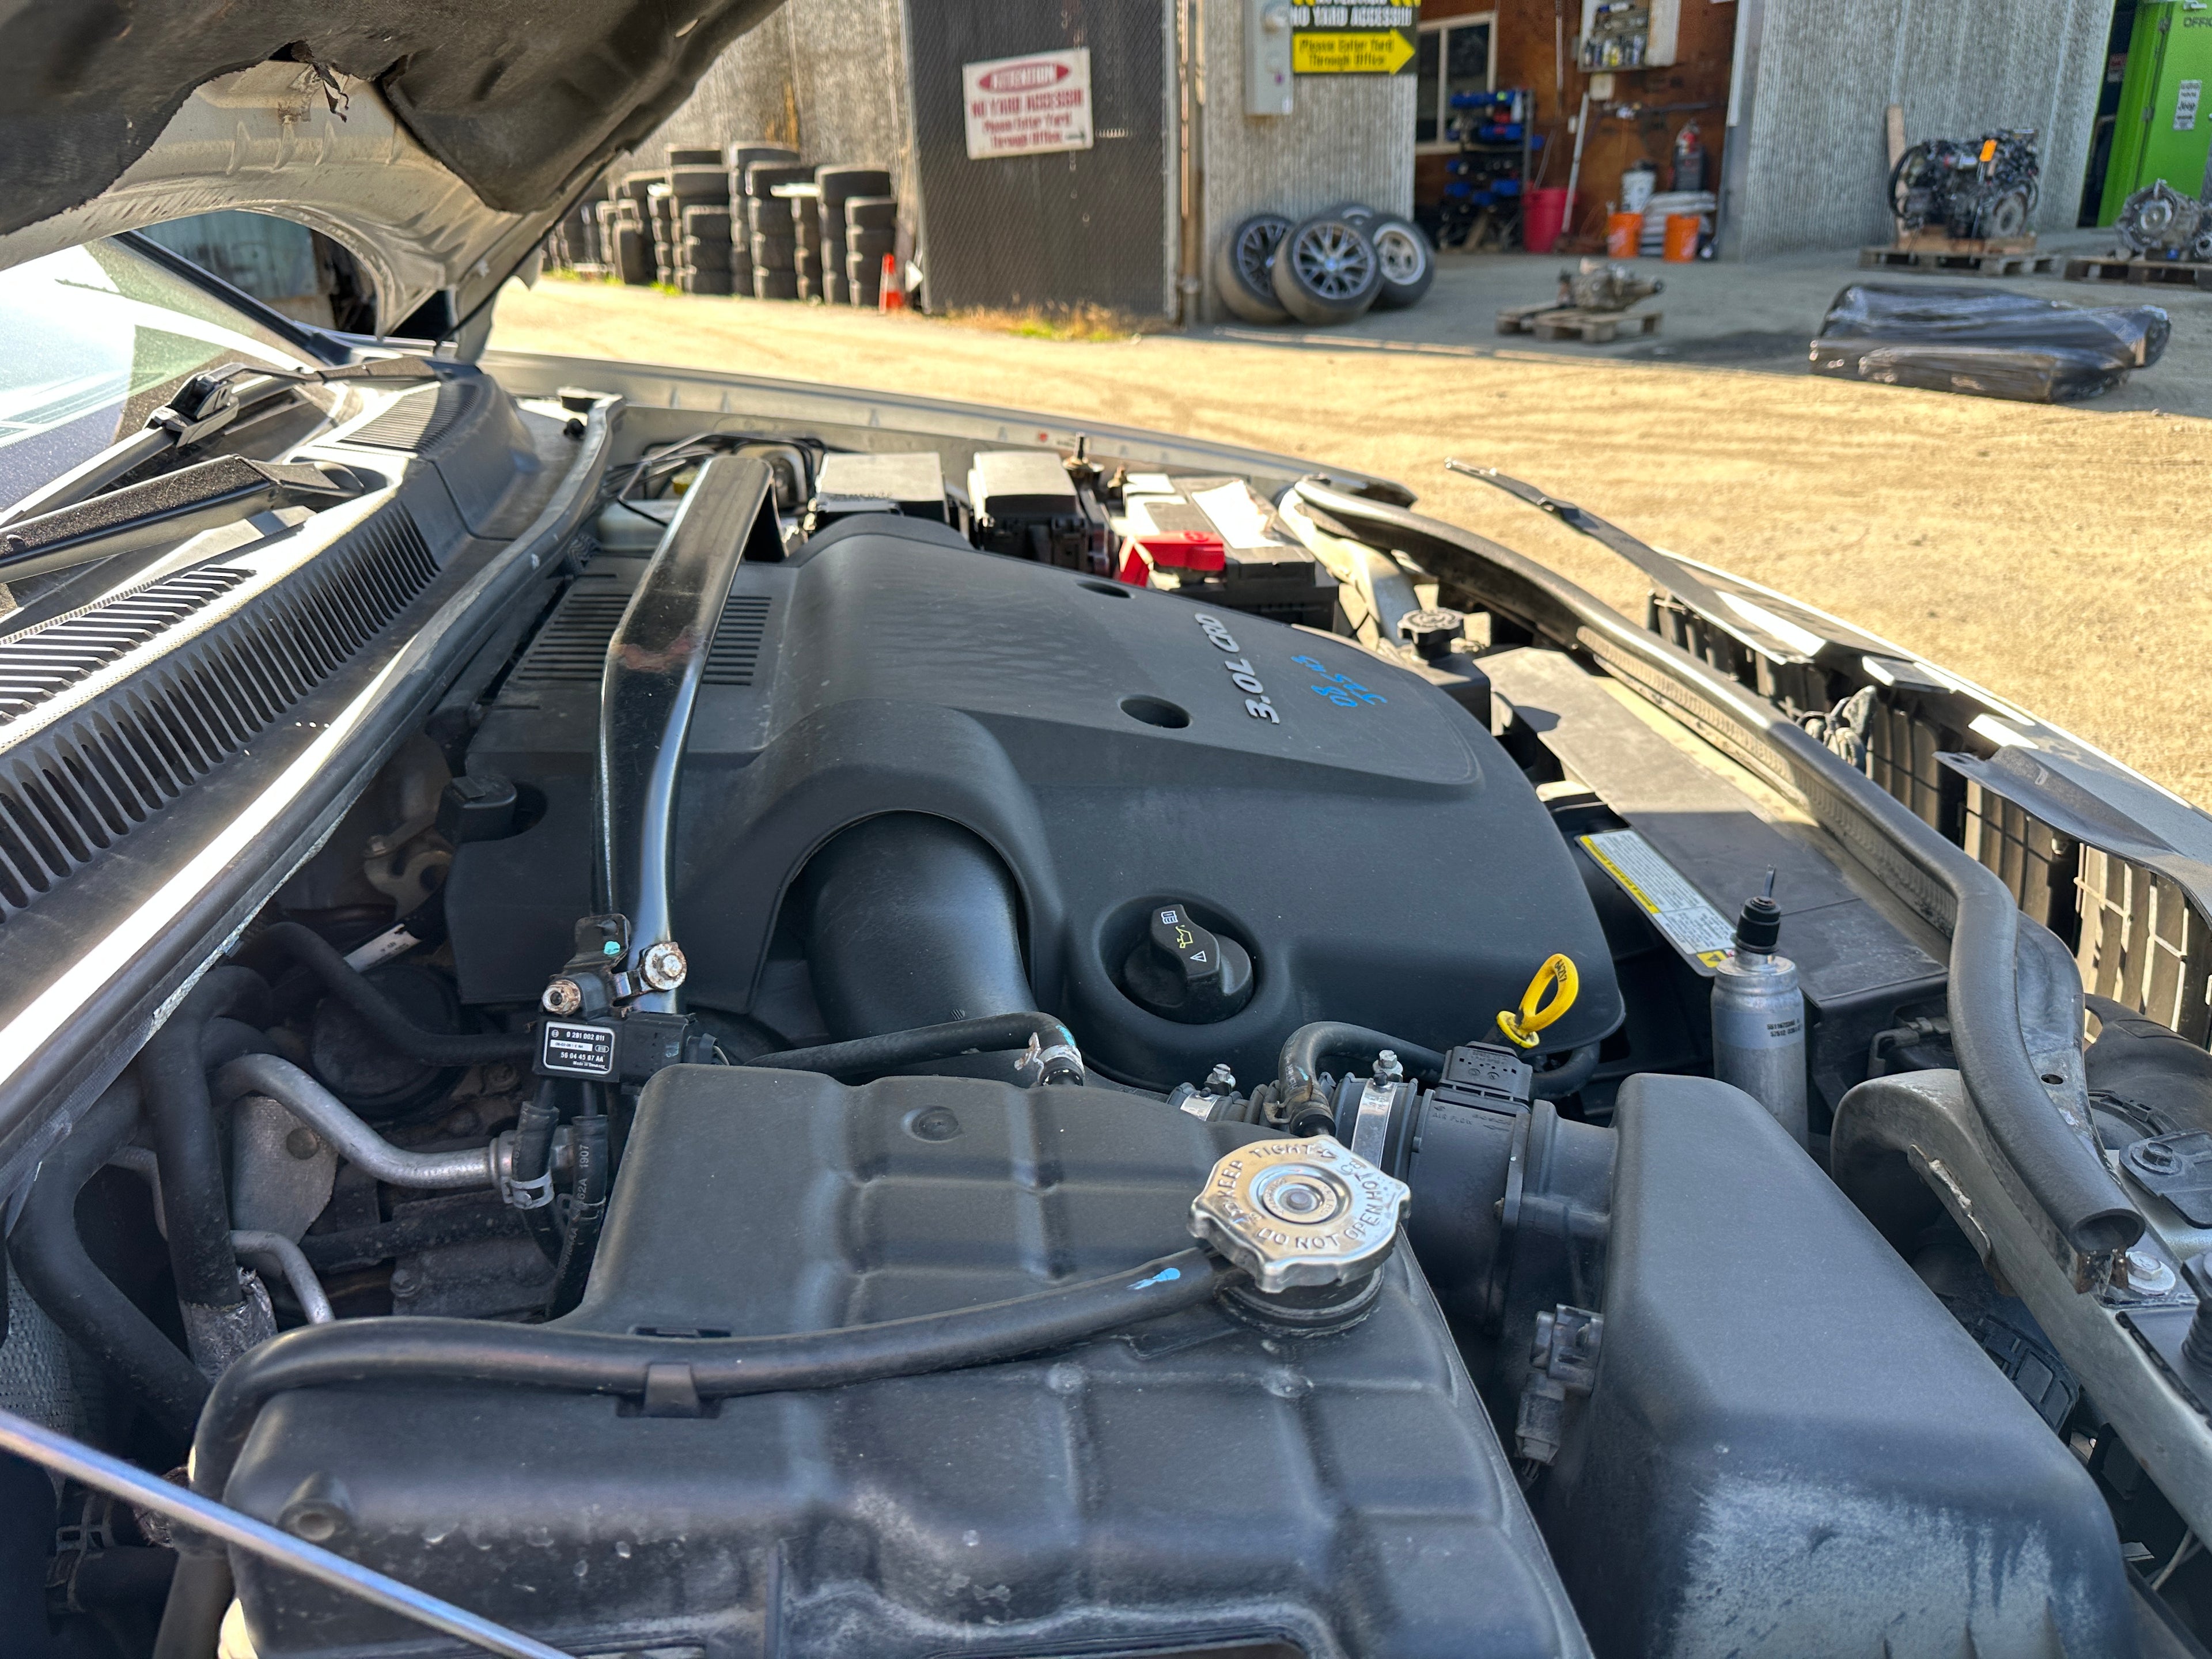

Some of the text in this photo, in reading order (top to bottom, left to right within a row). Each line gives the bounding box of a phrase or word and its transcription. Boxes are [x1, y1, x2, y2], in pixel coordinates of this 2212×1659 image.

[1313, 6, 1348, 26] YARD
[1194, 612, 1280, 725] 3.0L CRD
[579, 1144, 590, 1169] 1907
[1217, 1160, 1243, 1199] KEEP
[1248, 1143, 1315, 1158] TIGHT
[1353, 1171, 1383, 1201] HOT
[1257, 1227, 1290, 1246] DO
[1344, 1207, 1381, 1240] OPEN
[1295, 1232, 1342, 1250] NOT
